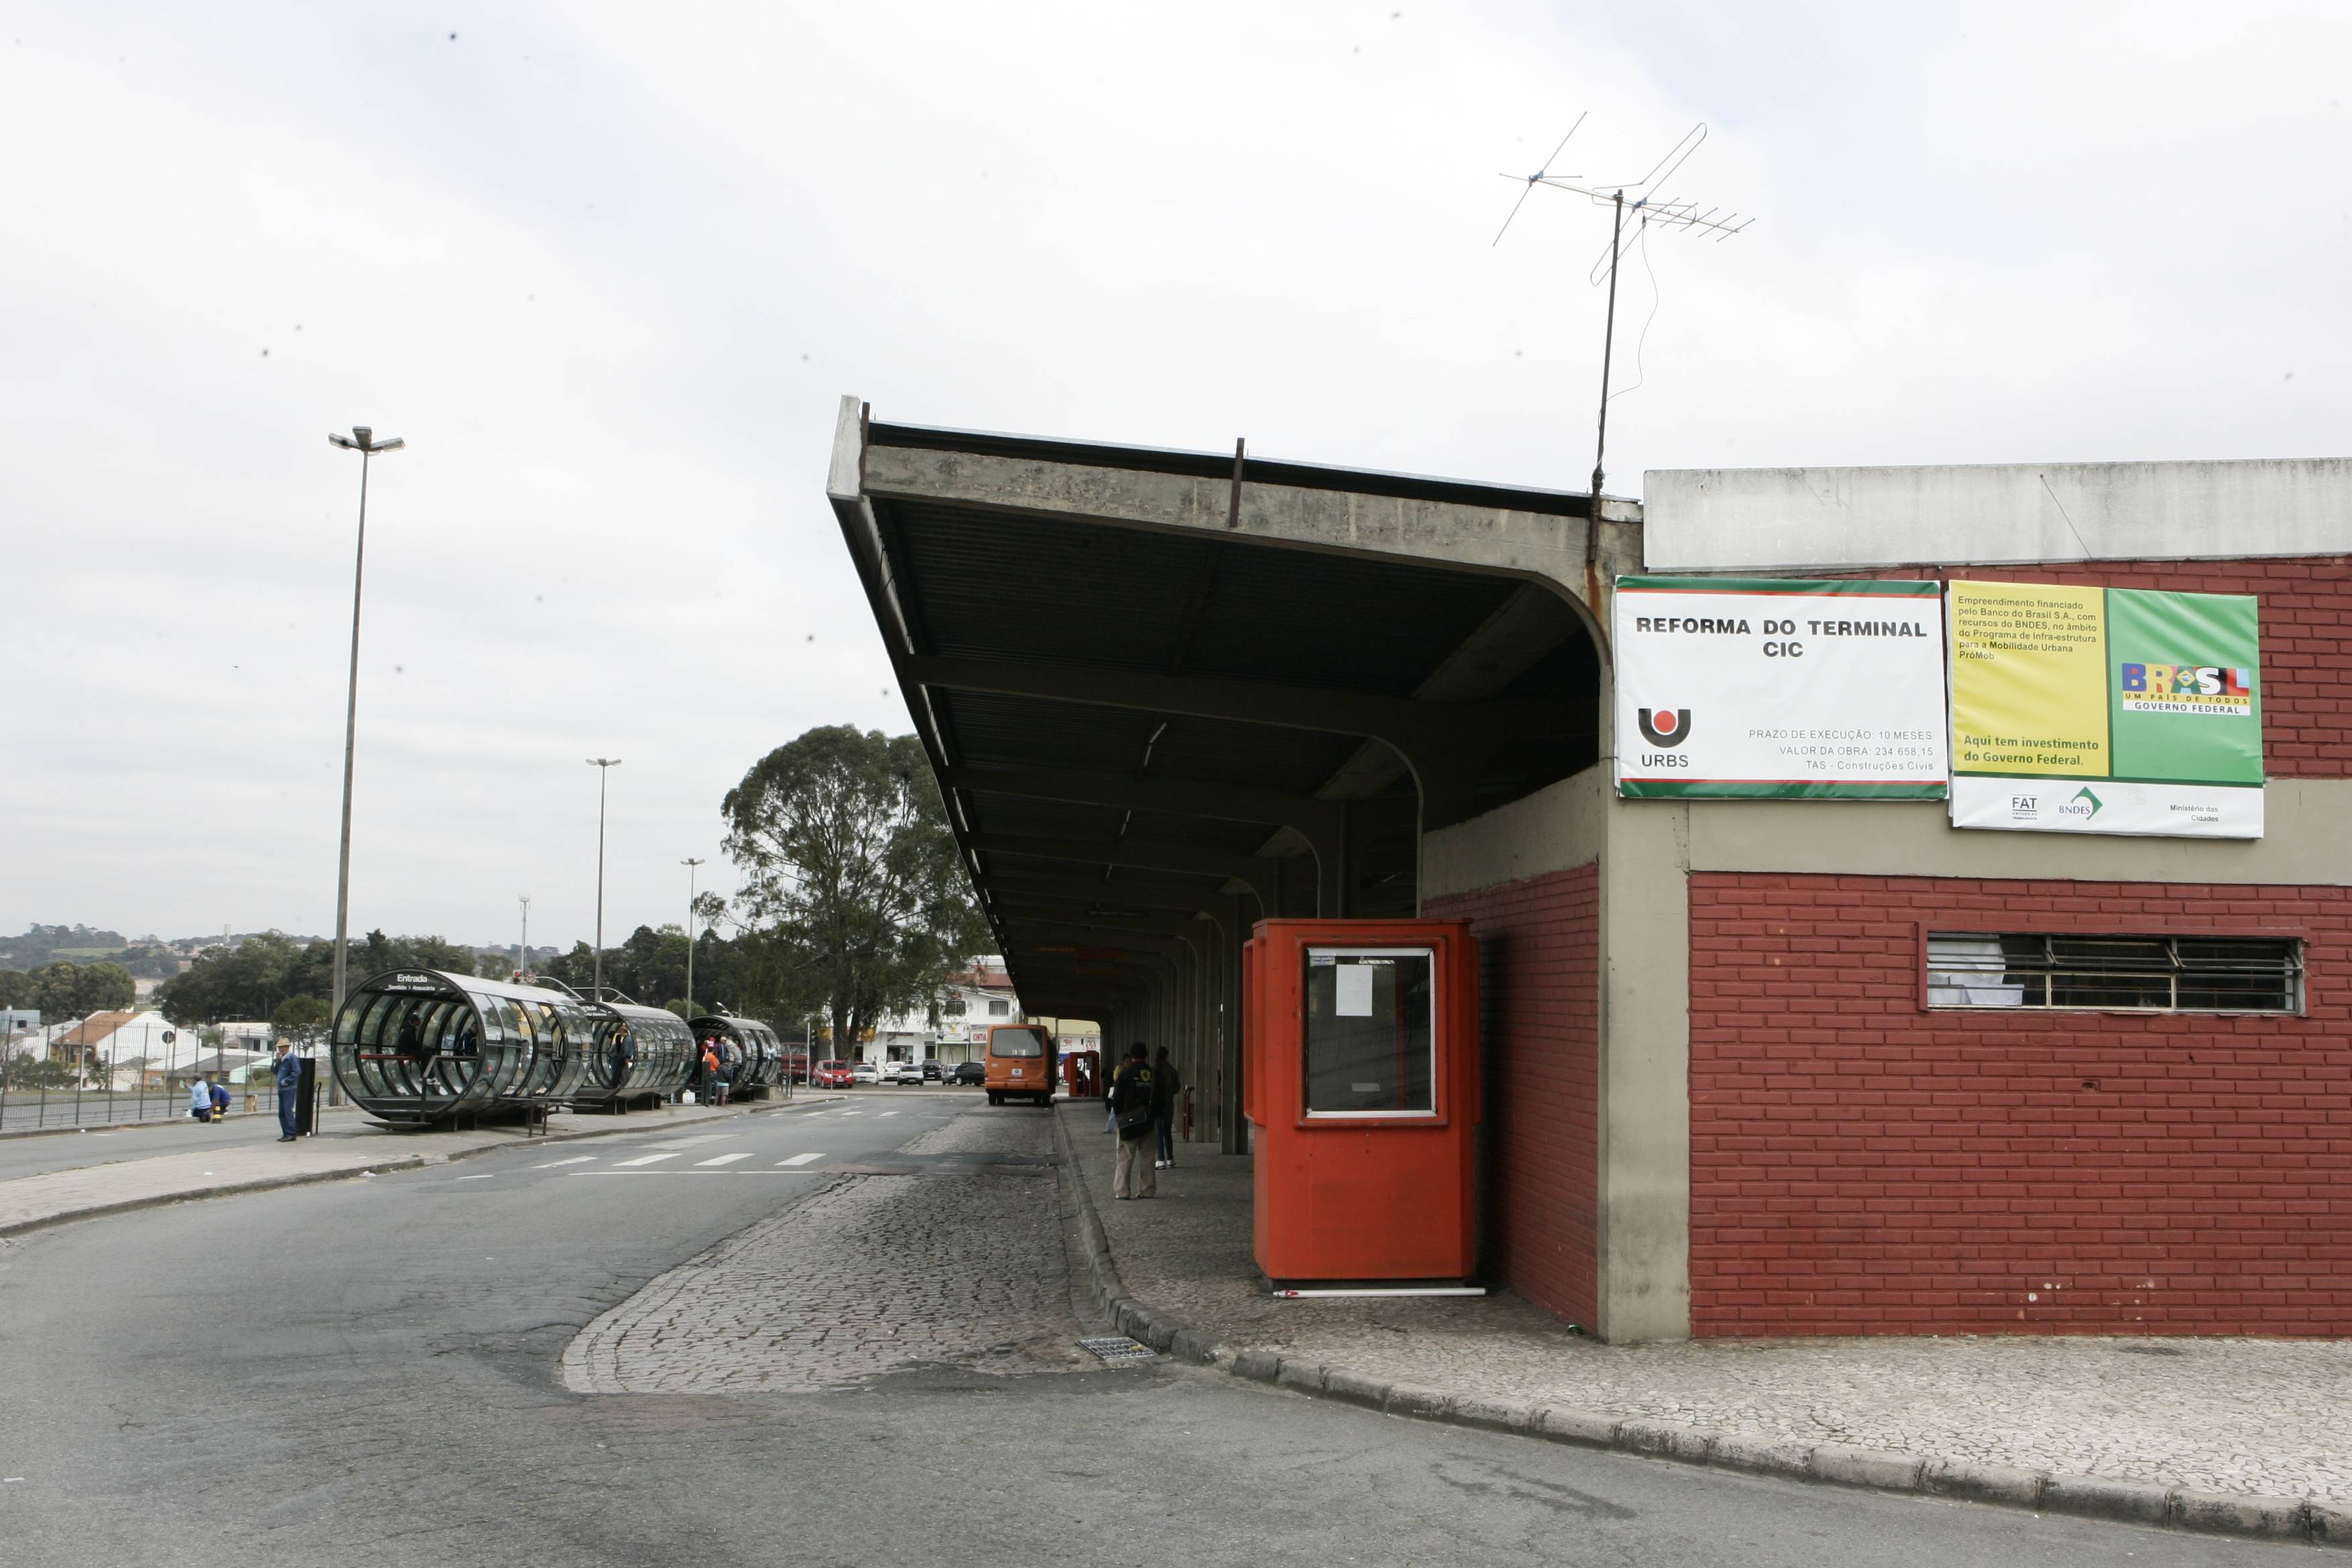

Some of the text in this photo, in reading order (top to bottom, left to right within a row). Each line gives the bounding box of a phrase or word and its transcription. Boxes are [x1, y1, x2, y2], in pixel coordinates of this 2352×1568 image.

[1958, 596, 2083, 609] Empreendimento financiado
[1981, 608, 2008, 617] Banco
[2012, 609, 2022, 618] do
[2026, 610, 2051, 618] Brasil
[2055, 611, 2073, 620] S.A.,
[1636, 618, 1927, 637] REFORMA DO TERMINAL
[2015, 622, 2050, 630] BNDES,
[2067, 623, 2097, 632] âmbito
[1973, 630, 2016, 640] Programa
[2020, 631, 2030, 640] de
[2033, 632, 2096, 642] Infra-estrutura
[1763, 642, 1803, 657] CIC
[1990, 642, 2038, 650] Mobilidade
[2041, 644, 2073, 652] Urbana
[1960, 650, 1994, 660] PróMob
[2122, 663, 2249, 696] BRASIL
[2135, 702, 2239, 714] GOVERNO FEDERAL
[1749, 730, 1787, 738] PRAZO
[1792, 730, 1806, 738] DE
[1810, 729, 1874, 741] EXECUÇÃO:
[1894, 732, 1932, 740] MESES
[1964, 735, 2098, 750] Aqui tem investimento
[1779, 746, 1816, 754] VALOR
[1820, 746, 1834, 754] DA
[1838, 747, 1871, 755] OBRA:
[1641, 754, 1688, 767] URBS
[1965, 751, 2084, 765] do Governo Federal.
[1837, 761, 1904, 771] Construções
[1908, 762, 1933, 770] Civis
[2012, 797, 2037, 808] FAT
[2059, 806, 2090, 814] BNDES
[397, 974, 427, 982] Entrada
